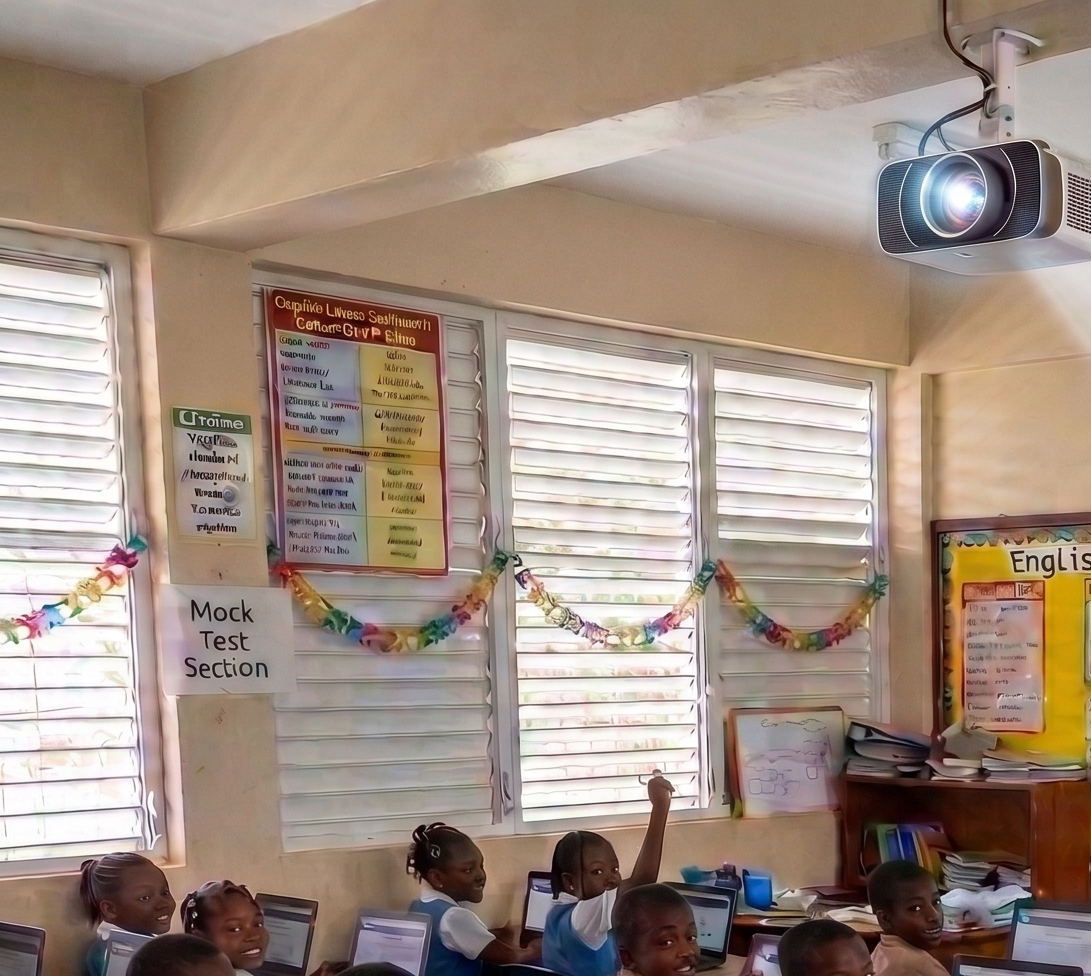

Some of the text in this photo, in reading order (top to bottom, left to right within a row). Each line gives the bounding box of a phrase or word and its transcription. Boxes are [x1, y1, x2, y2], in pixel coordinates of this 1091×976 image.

[191, 599, 254, 623] Mock
[199, 631, 250, 651] Test
[184, 657, 268, 678] Section
